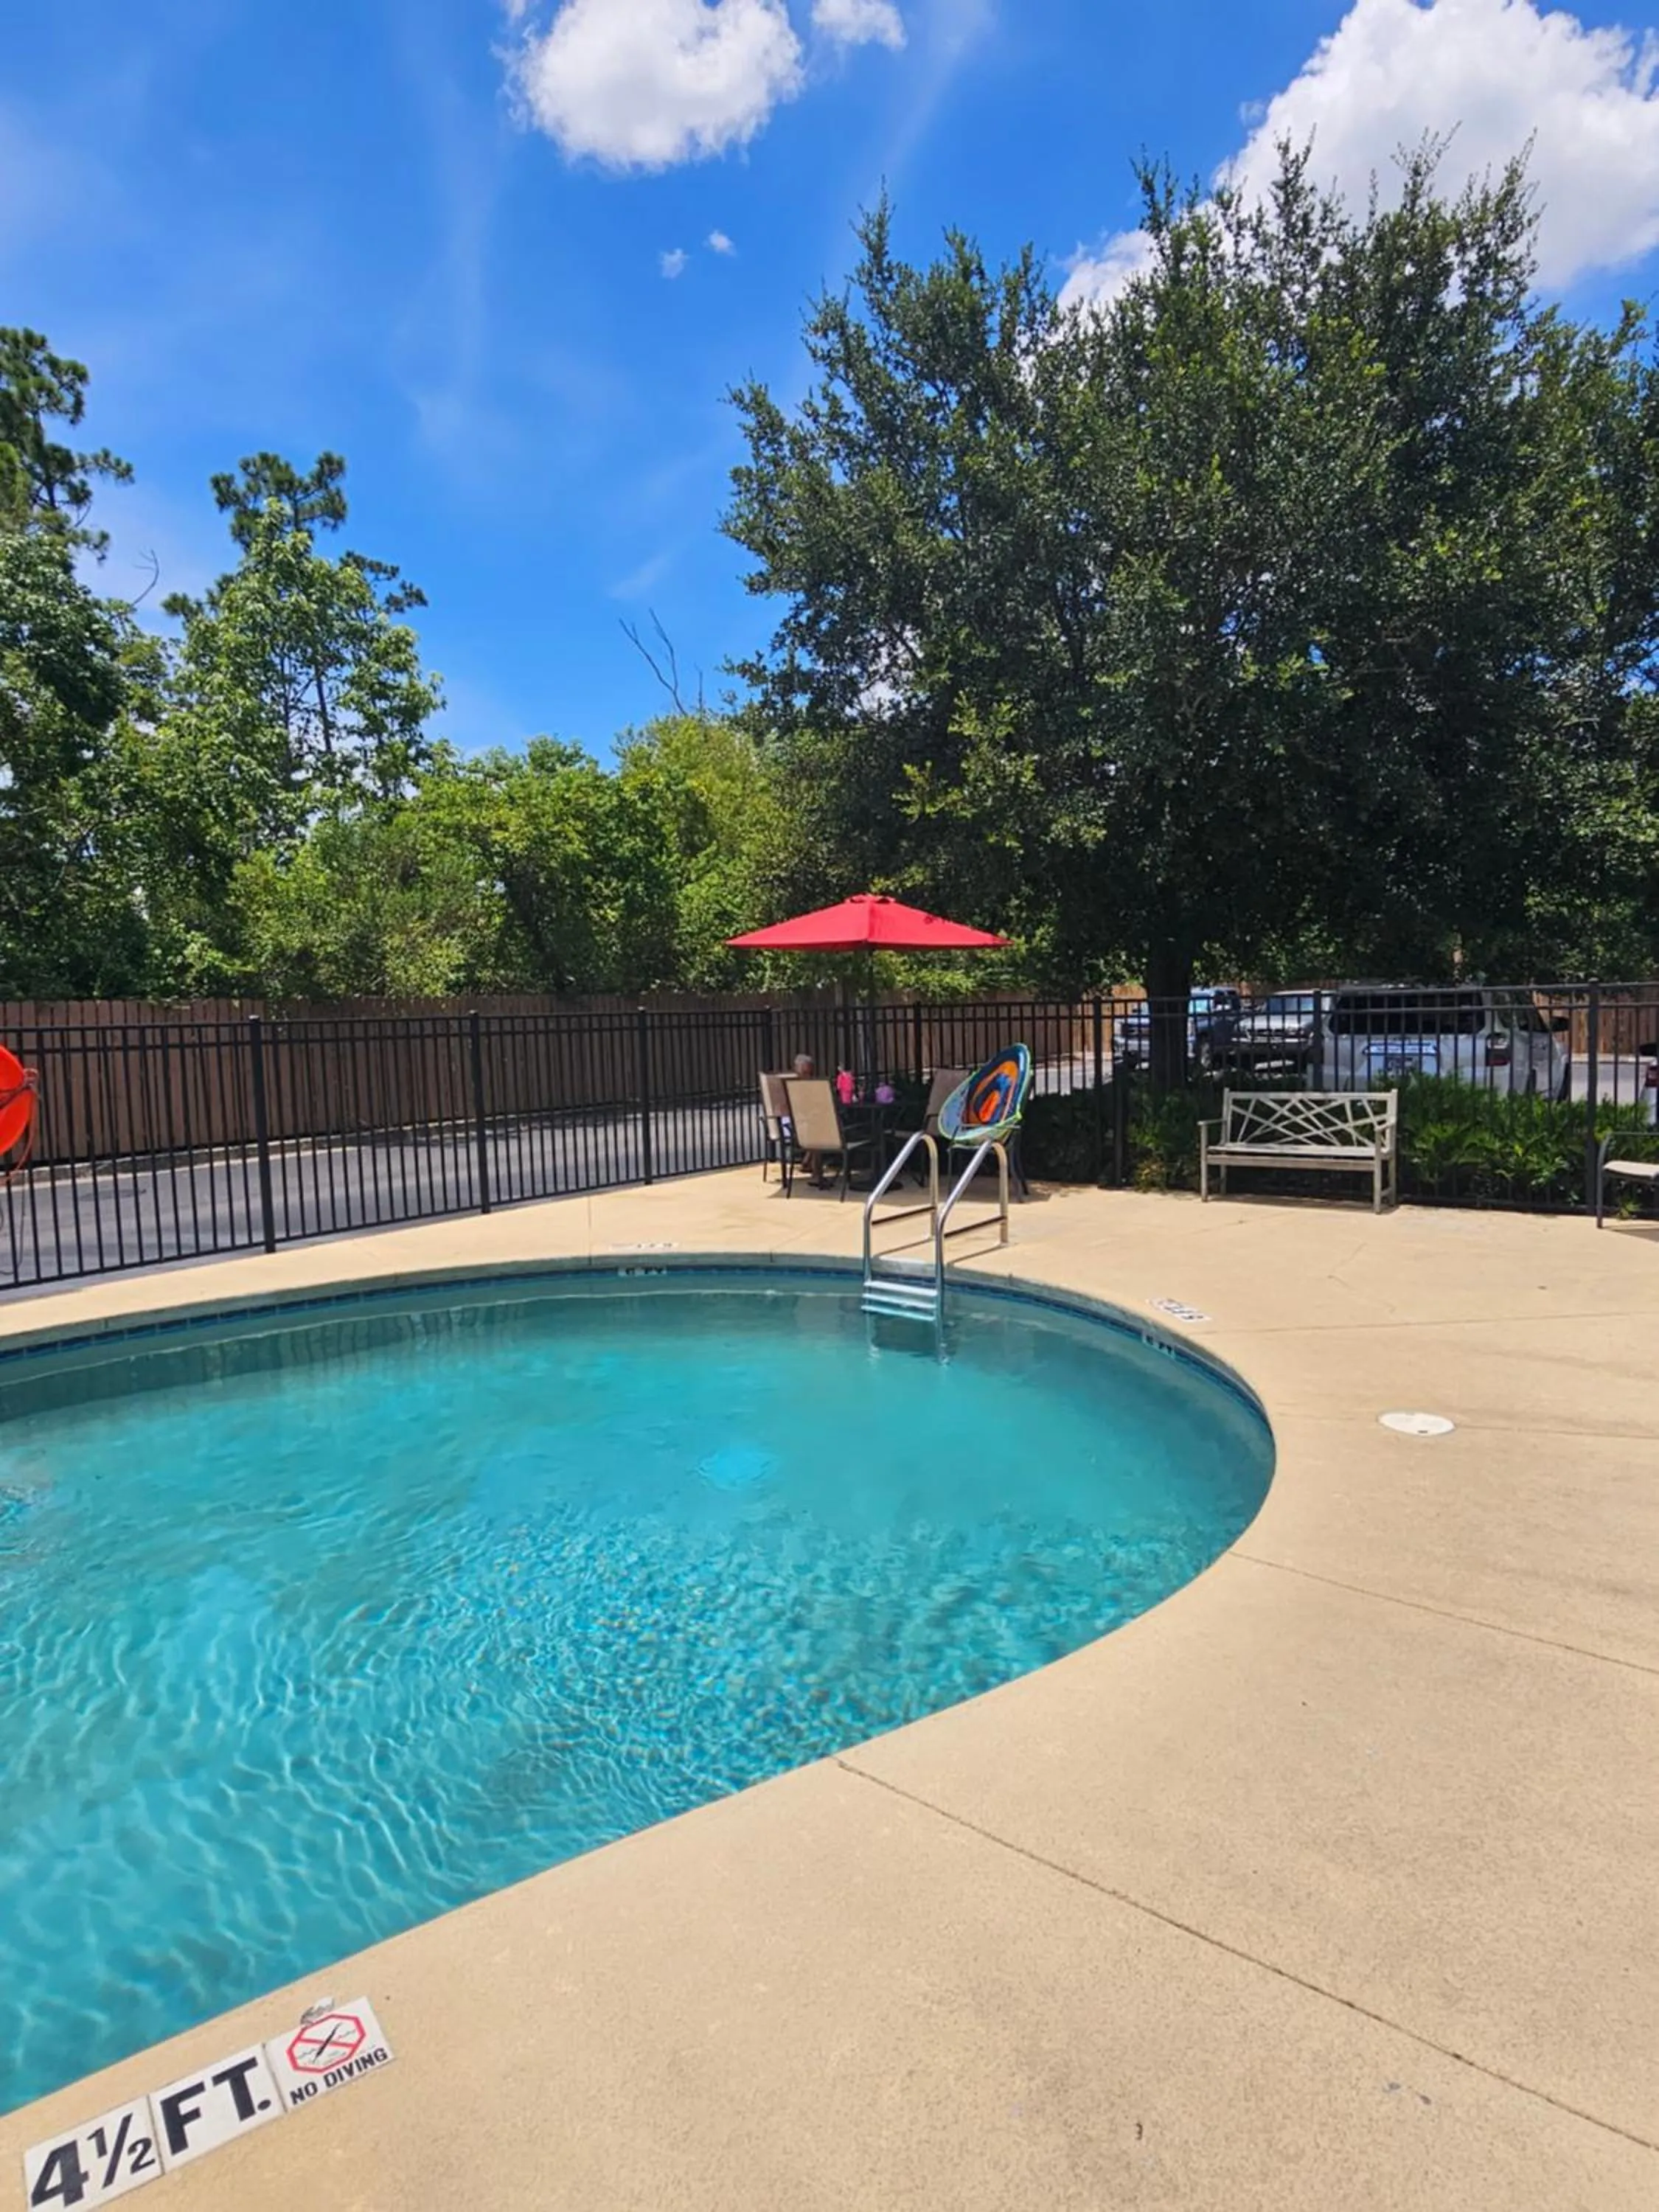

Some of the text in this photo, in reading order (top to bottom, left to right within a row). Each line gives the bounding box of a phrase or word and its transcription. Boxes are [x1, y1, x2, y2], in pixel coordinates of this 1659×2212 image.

[160, 2056, 271, 2155] FT.
[290, 2048, 389, 2104] NO DIVING
